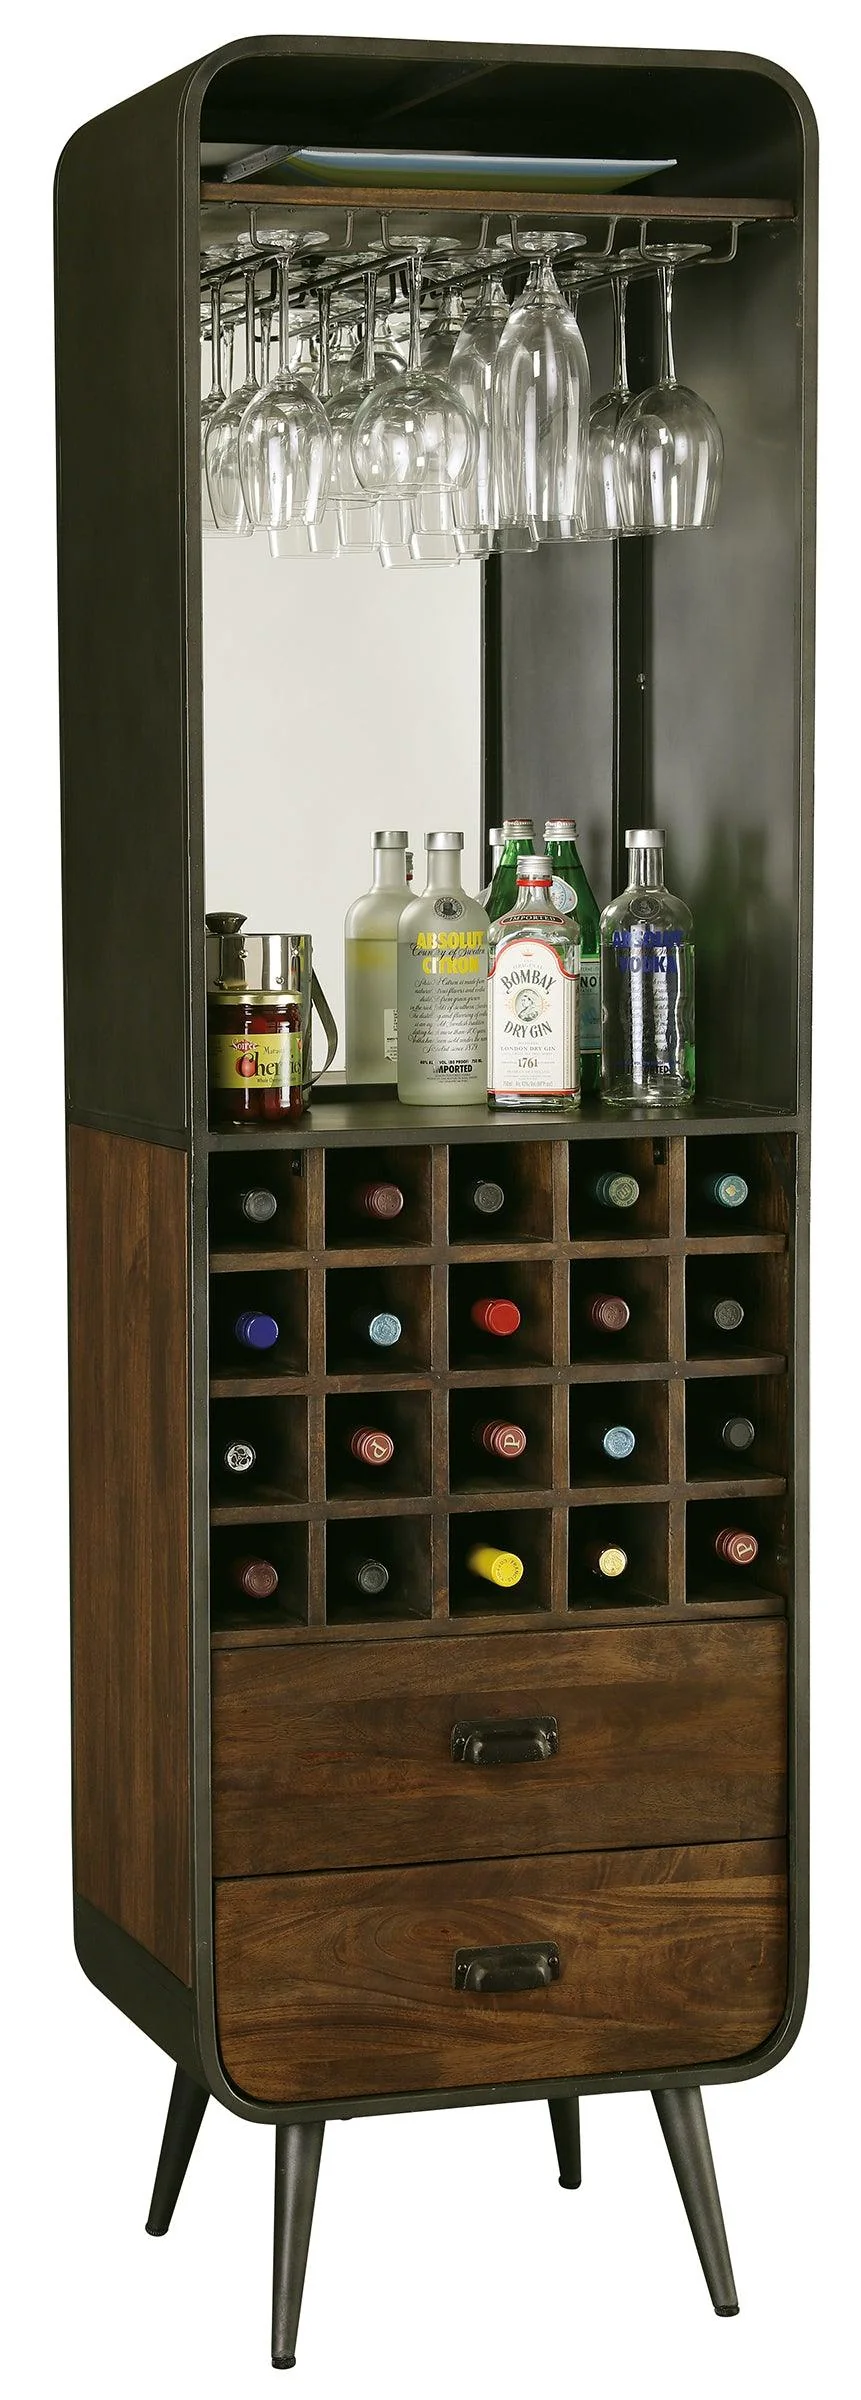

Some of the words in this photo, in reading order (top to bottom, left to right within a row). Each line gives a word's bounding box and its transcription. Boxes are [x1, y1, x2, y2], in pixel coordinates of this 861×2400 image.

[417, 930, 485, 949] ABSOLUT
[422, 957, 479, 975] CITRON
[500, 969, 556, 994] BOMBAY
[503, 1020, 528, 1038] DRY
[529, 1020, 553, 1039] GIN
[236, 1052, 302, 1078] Cherie
[433, 1064, 473, 1074] MPORTED
[518, 1057, 538, 1069] 1761
[370, 1439, 388, 1458] P
[504, 1433, 520, 1449] P
[736, 1542, 754, 1558] P
